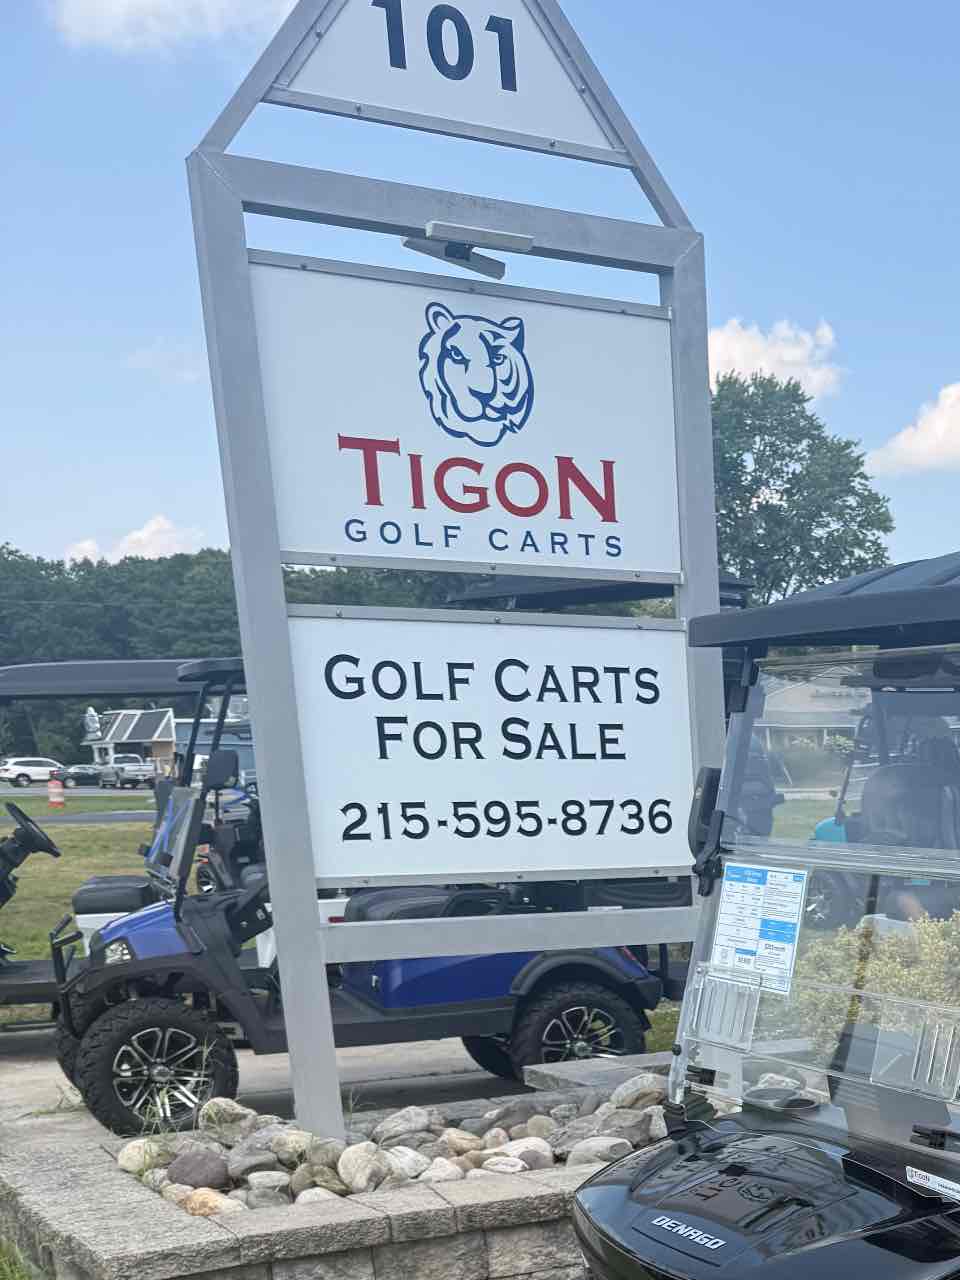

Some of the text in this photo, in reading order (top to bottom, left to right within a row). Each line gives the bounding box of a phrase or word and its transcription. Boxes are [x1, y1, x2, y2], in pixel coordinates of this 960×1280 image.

[370, 0, 518, 92] 101
[337, 433, 619, 523] TIGON
[344, 519, 623, 558] GOLF CARTS
[324, 653, 661, 705] GOLF CARTS
[375, 716, 627, 761] FOR SALE
[340, 798, 673, 842] 215-595-8736
[651, 1215, 728, 1250] DENAGO
